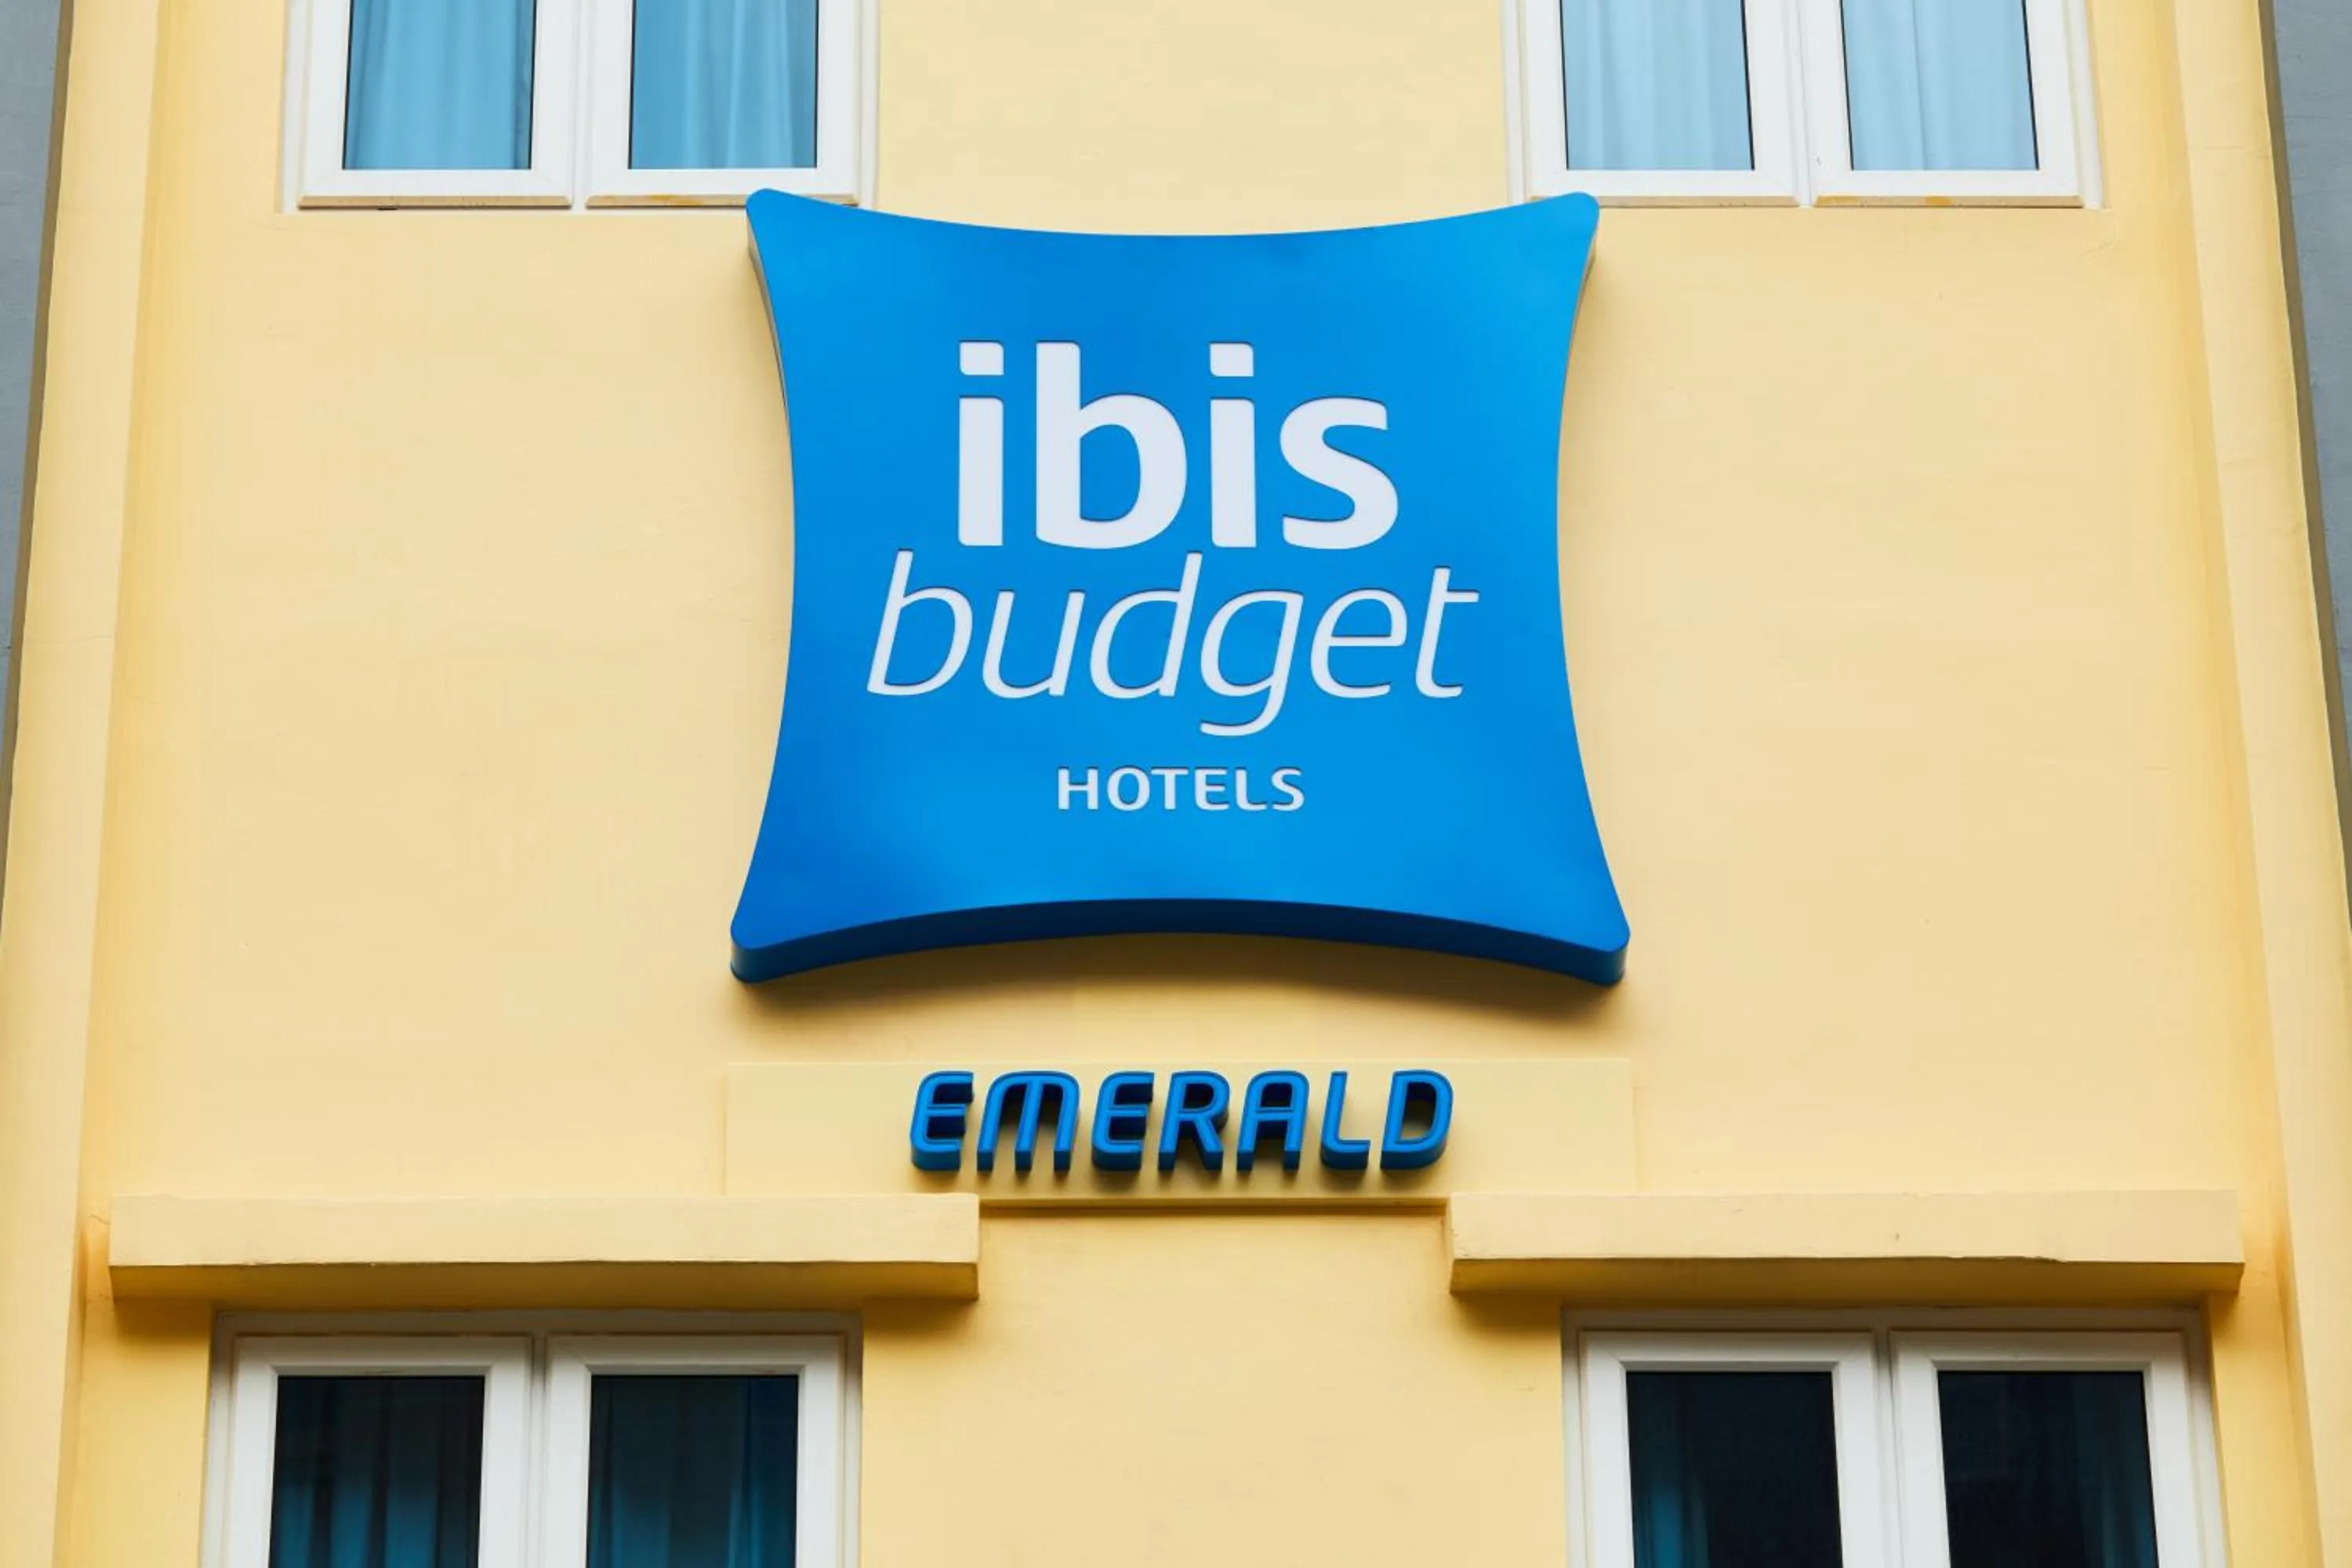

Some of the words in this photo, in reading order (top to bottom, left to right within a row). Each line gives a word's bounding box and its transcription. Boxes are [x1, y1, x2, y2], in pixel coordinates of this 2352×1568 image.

[958, 341, 1399, 550] ibis
[866, 550, 1479, 737] budget
[1057, 767, 1305, 811] HOTELS
[909, 1069, 1454, 1171] EMERALD
